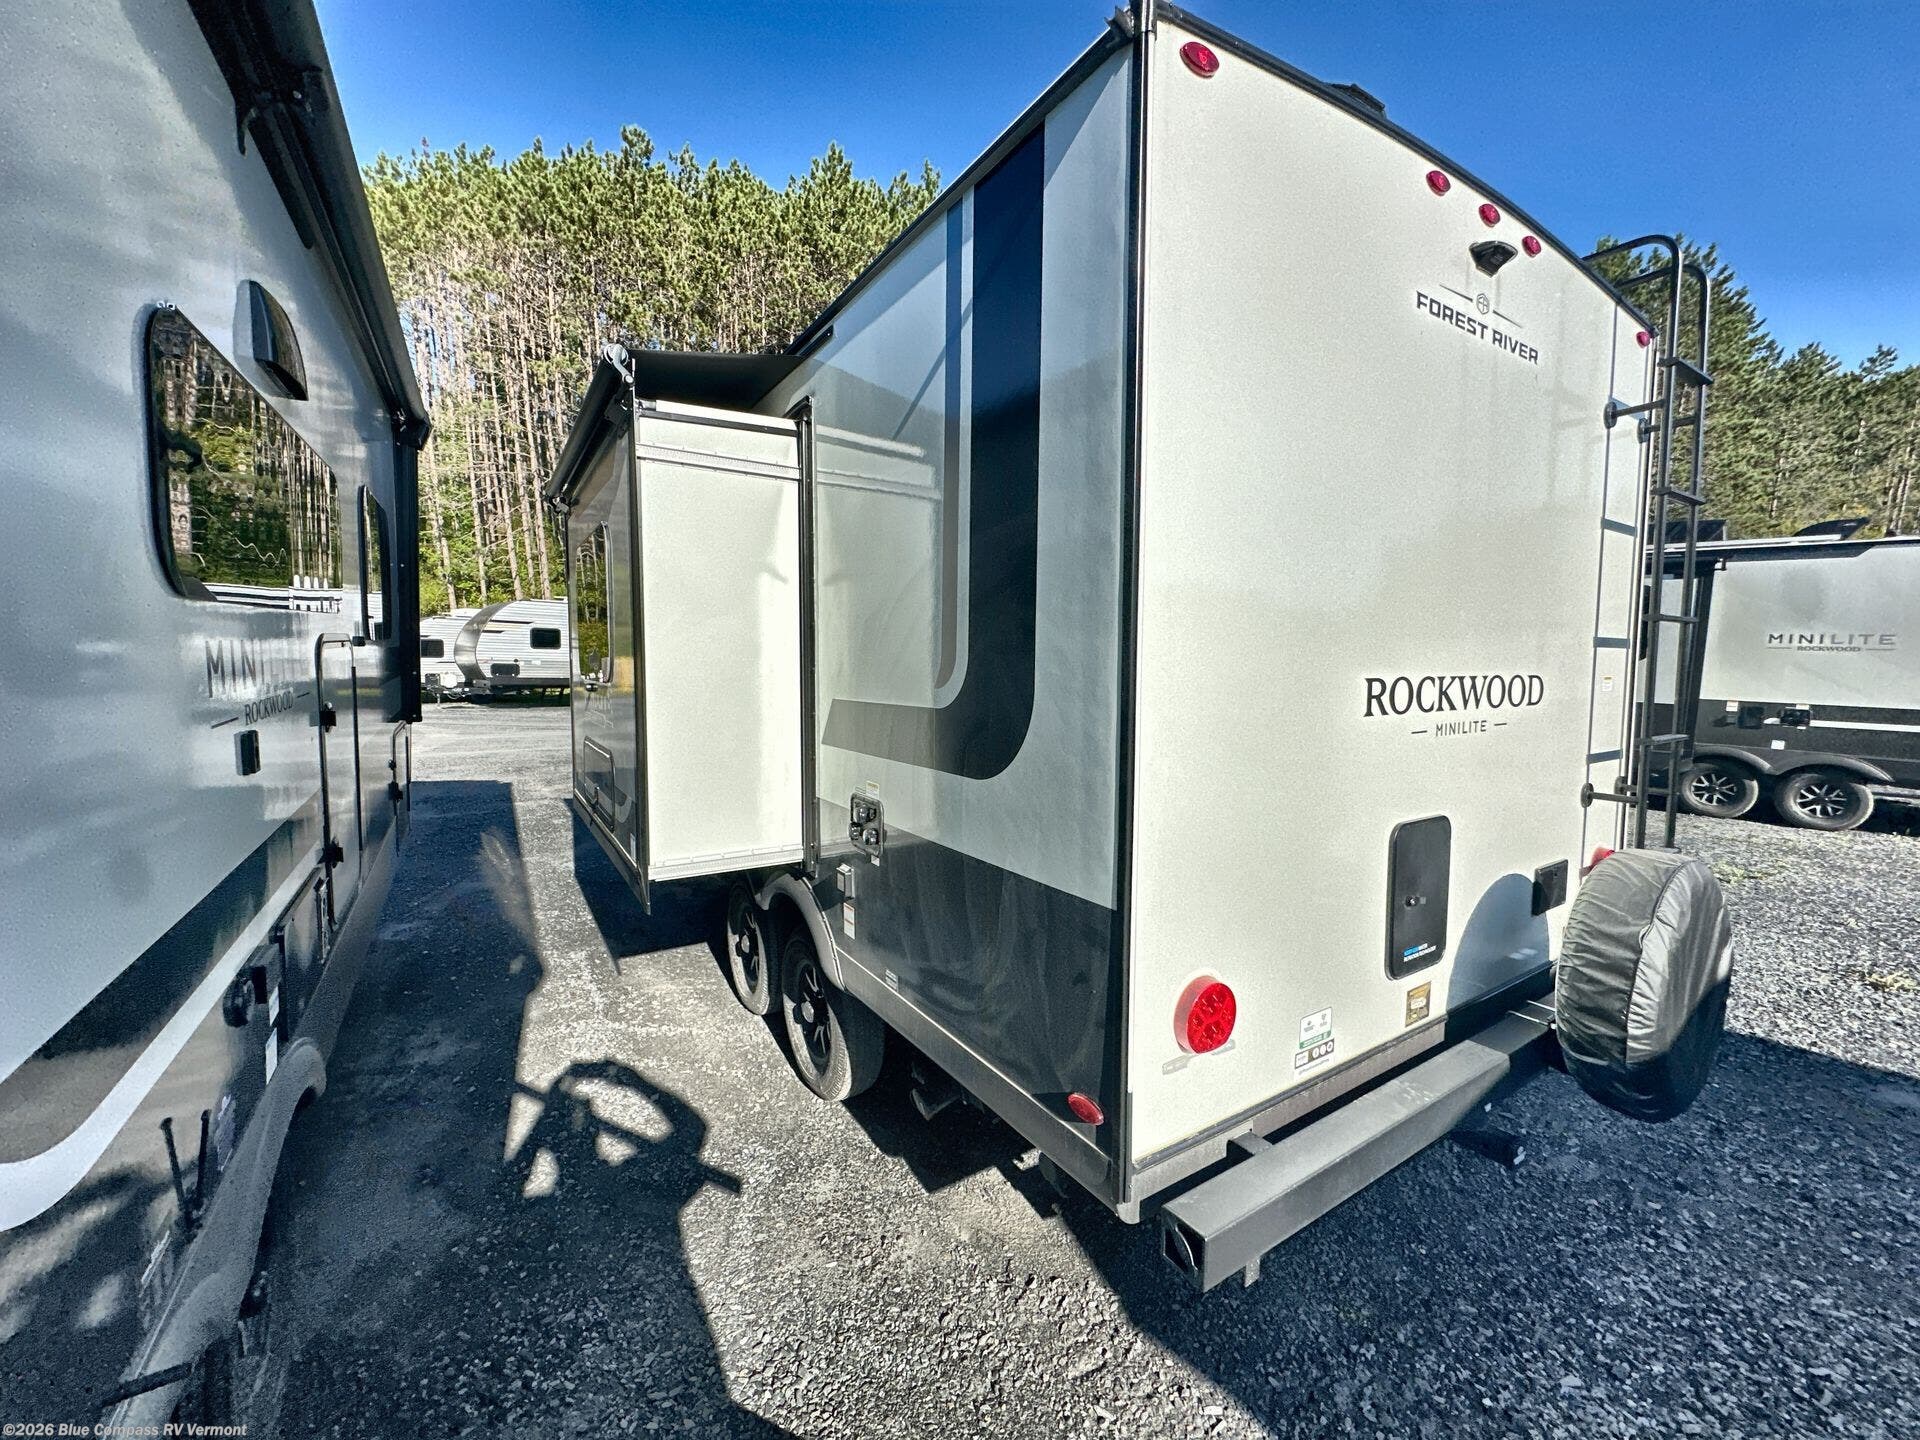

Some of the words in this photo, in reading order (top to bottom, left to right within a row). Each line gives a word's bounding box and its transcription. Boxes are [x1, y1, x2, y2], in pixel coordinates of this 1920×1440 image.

[1416, 291, 1488, 339] FOREST
[1492, 329, 1539, 365] RIVER
[1768, 633, 1897, 646] MINILITE
[244, 690, 294, 726] ROCKWOOD
[1363, 674, 1544, 718] ROCKWOOD
[1435, 720, 1487, 737] MINILITE
